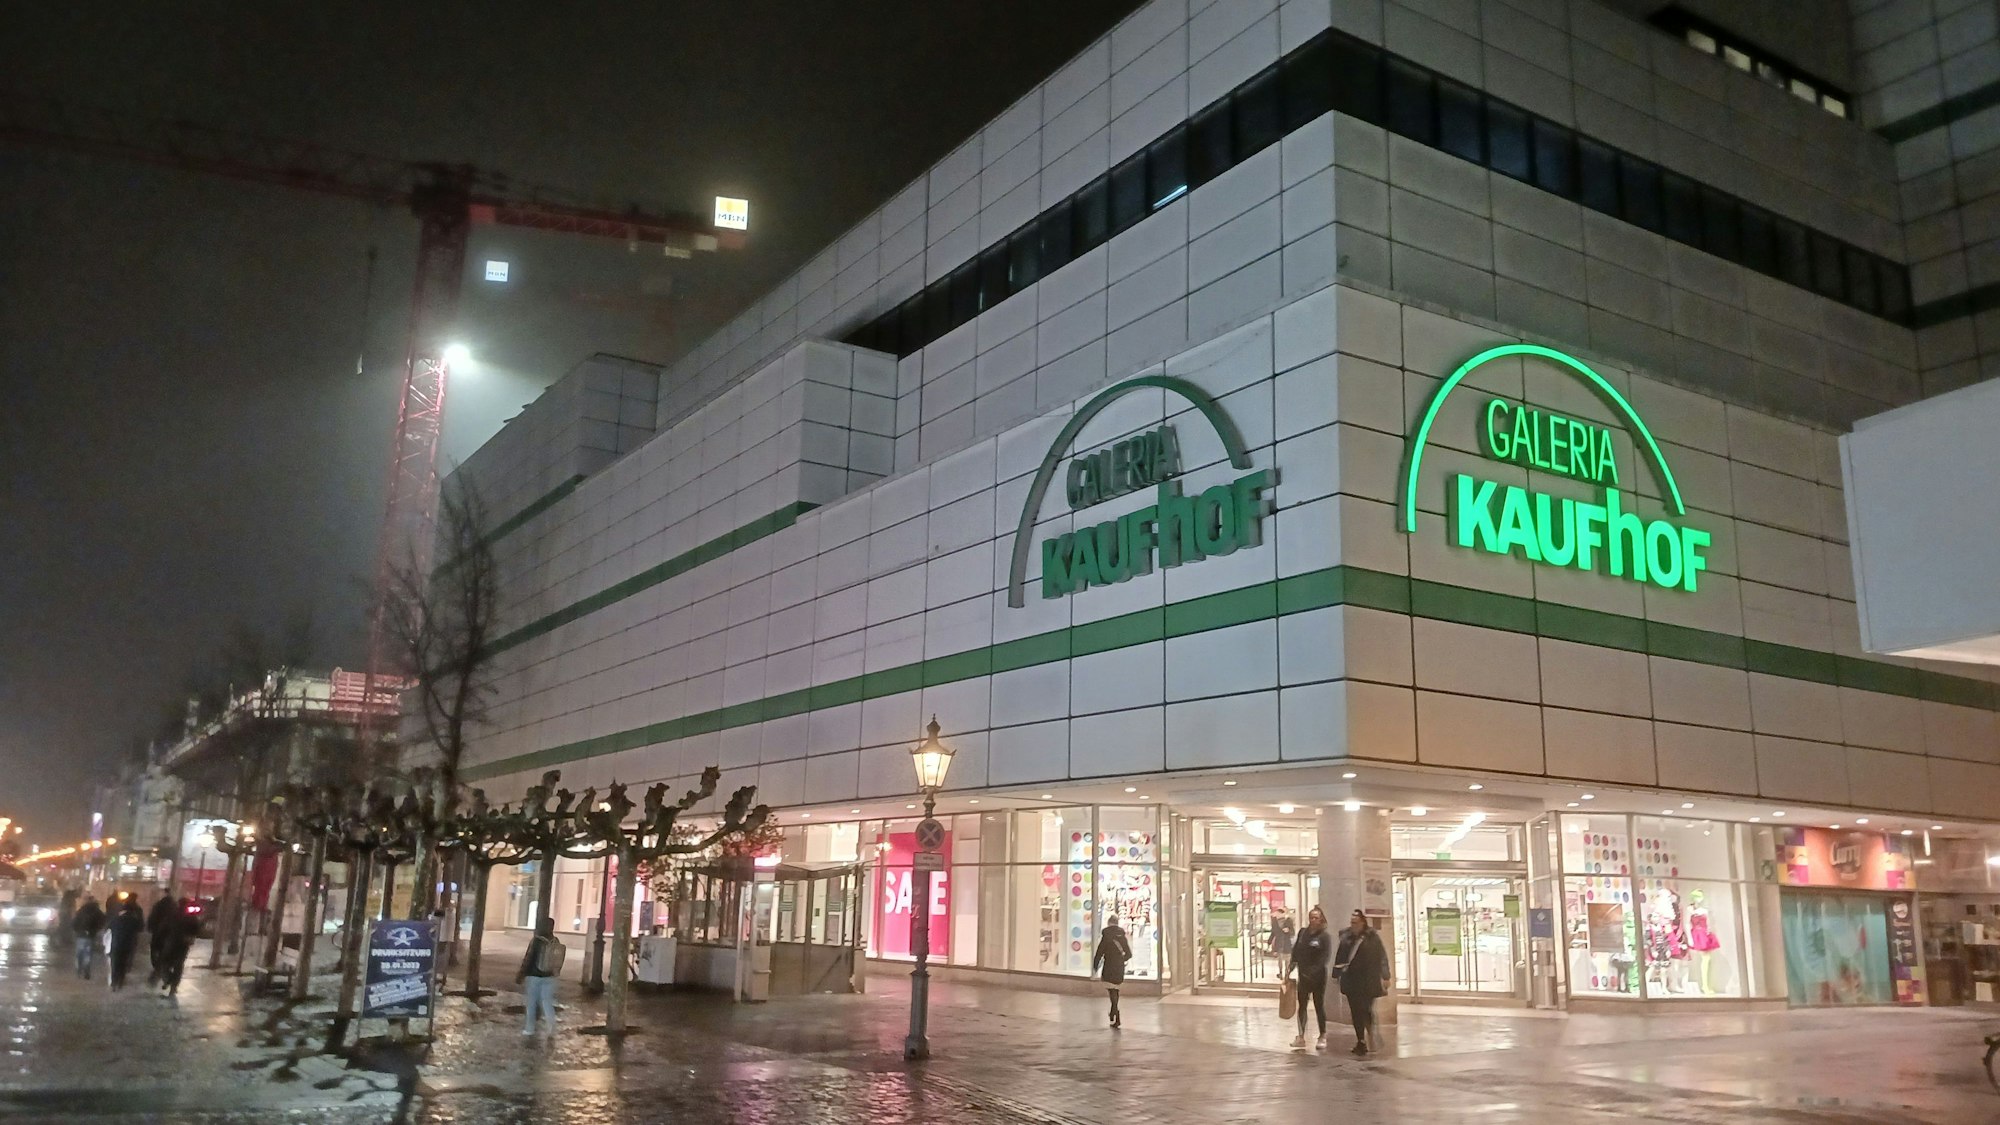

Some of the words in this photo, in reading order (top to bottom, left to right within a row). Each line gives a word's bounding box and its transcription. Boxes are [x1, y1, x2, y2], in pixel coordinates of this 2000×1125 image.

[1067, 424, 1182, 510] GALERIA
[1487, 399, 1619, 485] GALERIA
[885, 870, 948, 915] SAE
